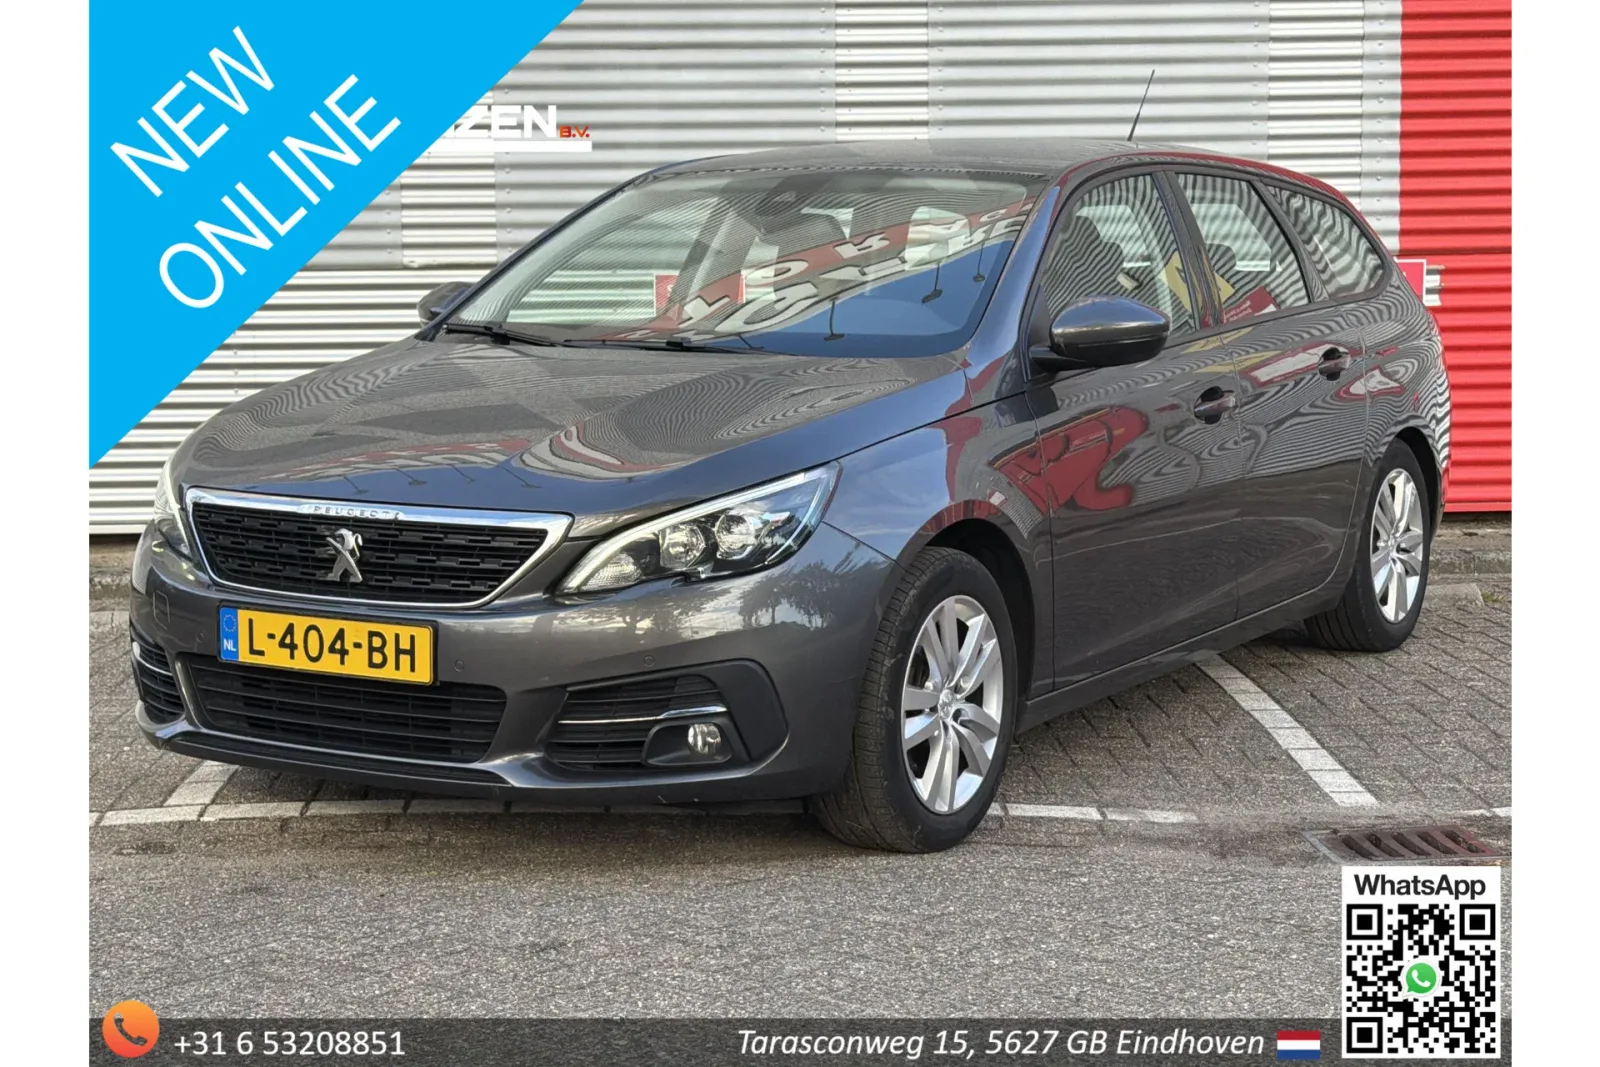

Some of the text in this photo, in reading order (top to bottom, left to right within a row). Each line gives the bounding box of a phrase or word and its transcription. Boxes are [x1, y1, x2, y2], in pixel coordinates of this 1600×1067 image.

[313, 504, 390, 519] PEUGEOT
[223, 638, 237, 652] NL
[248, 618, 415, 673] L-404-BH
